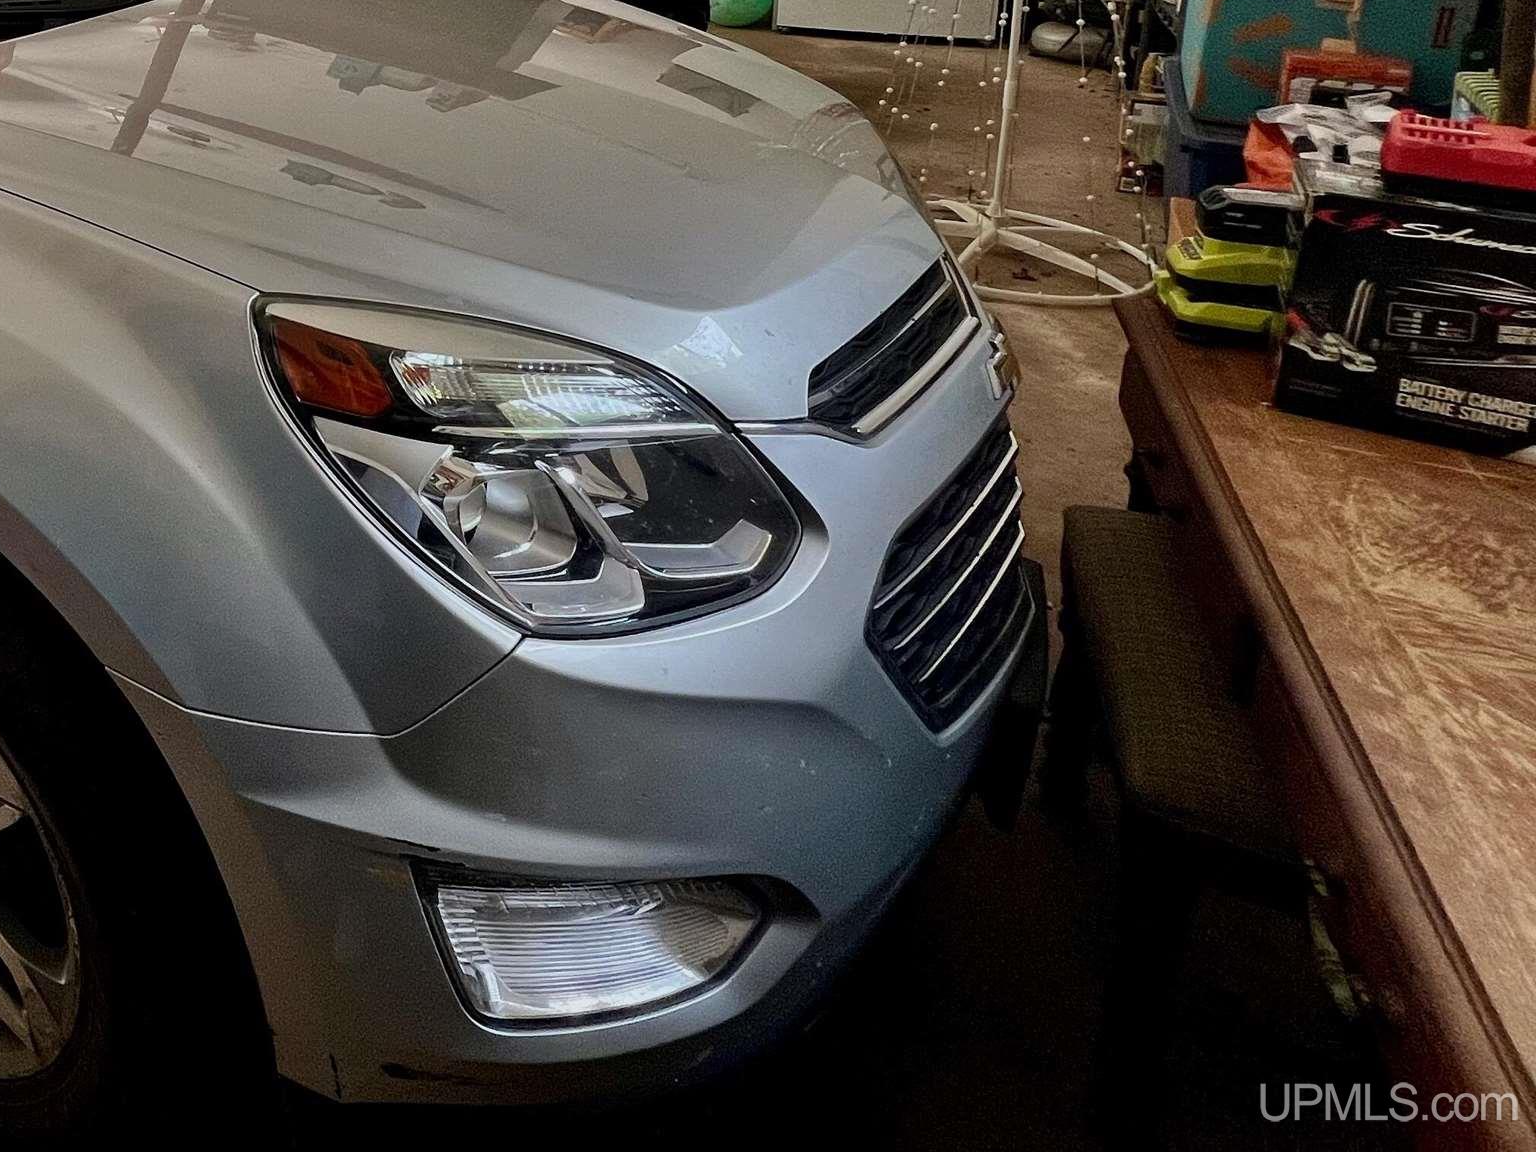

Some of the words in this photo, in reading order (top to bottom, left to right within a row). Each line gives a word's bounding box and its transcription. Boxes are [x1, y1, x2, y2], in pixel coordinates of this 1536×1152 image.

[1399, 377, 1468, 404] BATTERY
[1395, 392, 1457, 418] ENGINE
[1457, 405, 1531, 433] STARTER
